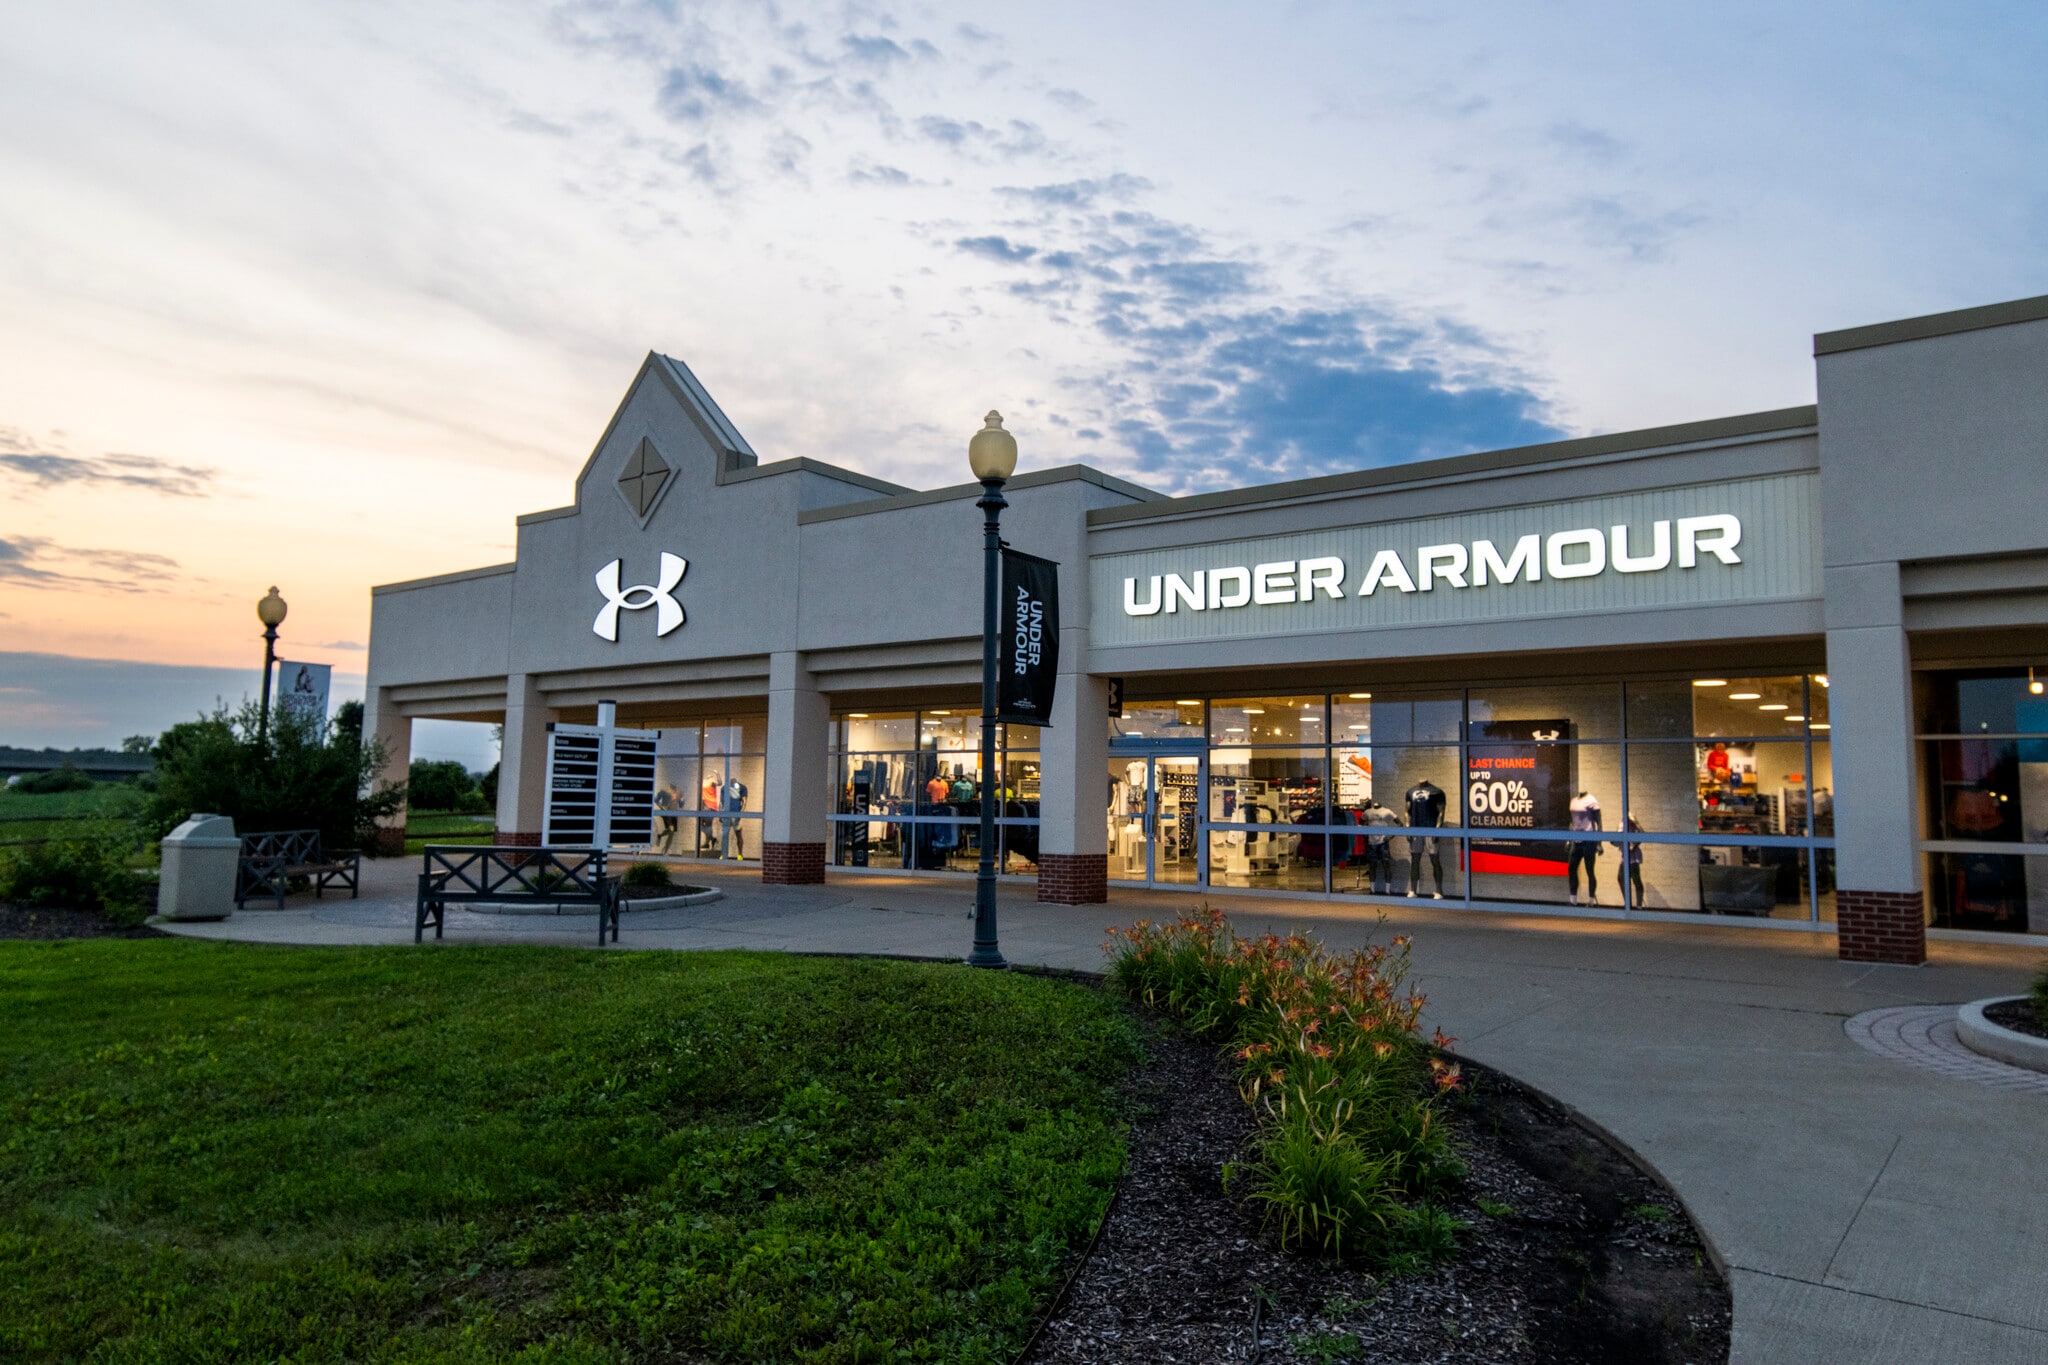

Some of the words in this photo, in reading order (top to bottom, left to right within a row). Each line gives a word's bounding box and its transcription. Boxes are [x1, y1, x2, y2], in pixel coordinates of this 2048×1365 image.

[1124, 557, 1346, 616] UNDER
[1359, 514, 1742, 596] ARMOUR
[1015, 586, 1029, 675] ARMOUR
[1028, 601, 1043, 666] UNDER
[1470, 758, 1493, 769] LAST
[1495, 758, 1535, 769] CHANCE
[1470, 771, 1481, 780] UP
[1481, 771, 1491, 780] TO
[1470, 781, 1528, 813] 60%
[1508, 800, 1533, 813] OFF
[1471, 816, 1533, 827] CLEARANCE
